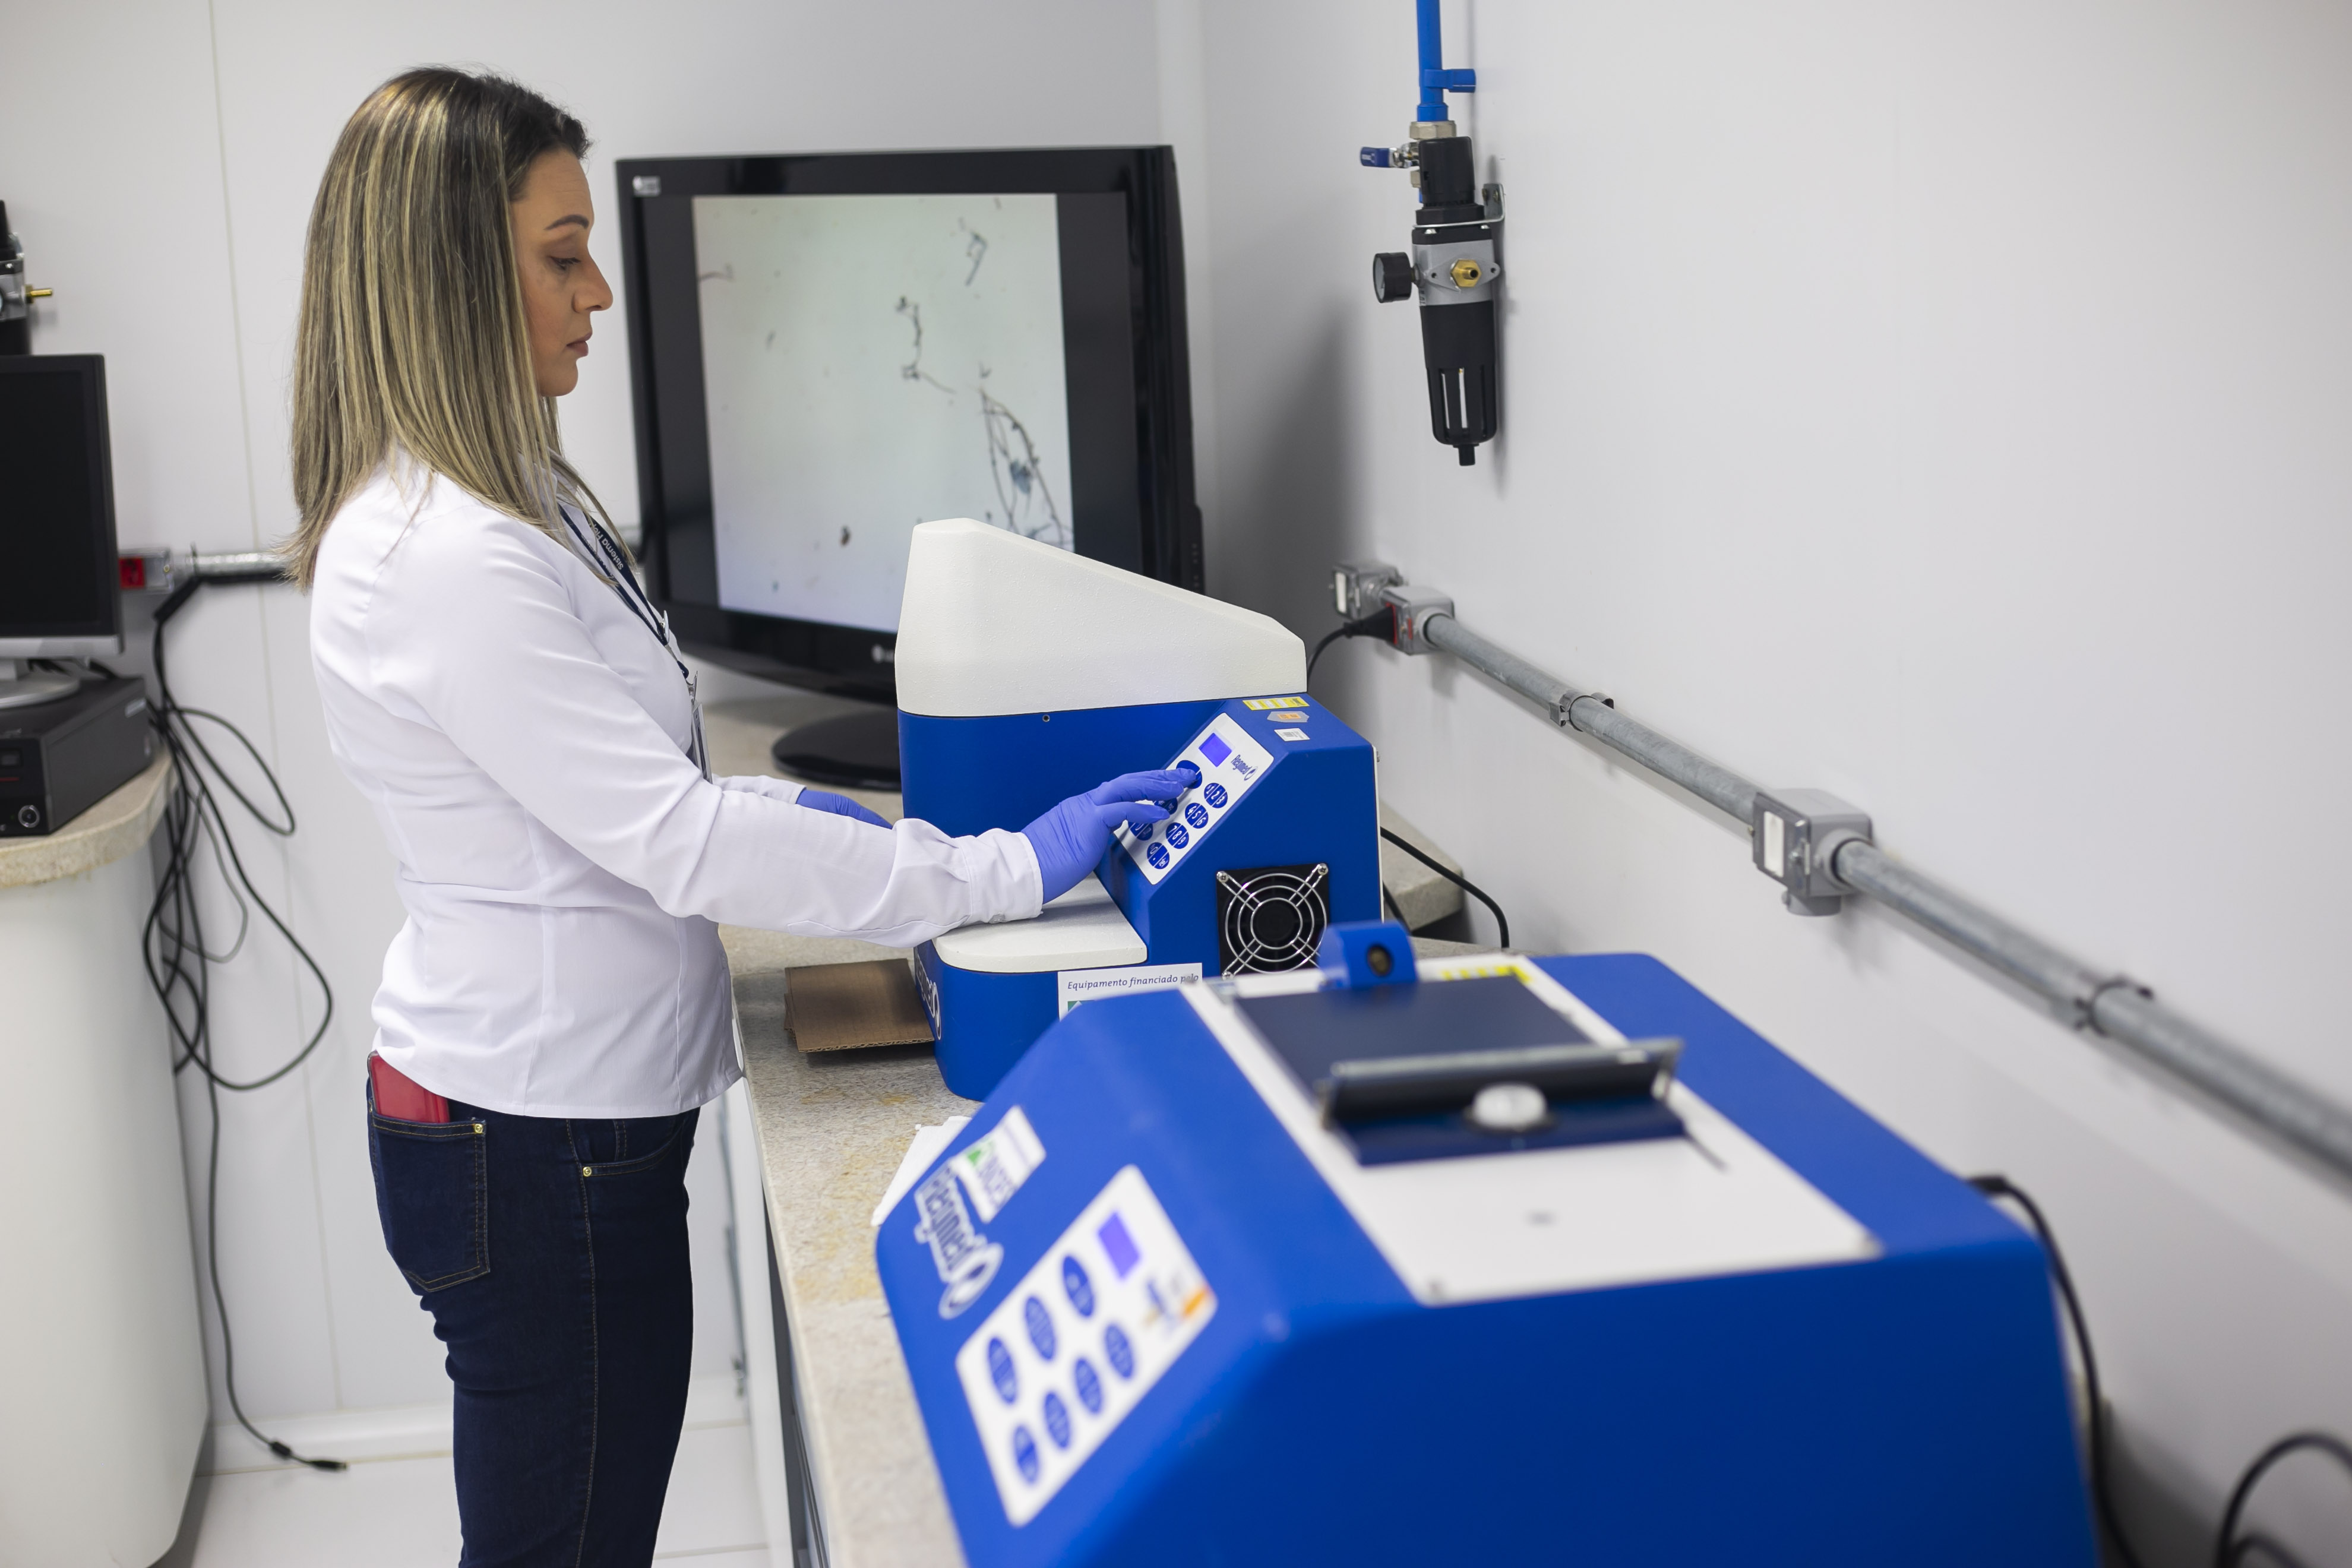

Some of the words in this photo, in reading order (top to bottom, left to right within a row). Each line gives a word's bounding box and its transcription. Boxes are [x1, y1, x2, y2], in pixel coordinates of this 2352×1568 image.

[601, 538, 624, 570] Sistema
[1206, 786, 1215, 794] 1
[1211, 791, 1220, 799] 2
[1216, 796, 1225, 805] 3
[1187, 805, 1197, 815] 4
[1191, 810, 1202, 819] 5
[1196, 817, 1206, 826] 6
[1168, 825, 1178, 834] 7
[1172, 830, 1183, 840] 8
[1177, 836, 1187, 845] 9
[1067, 978, 1128, 991] Equipamento
[1128, 974, 1178, 988] financiado
[1180, 973, 1199, 984] pelo
